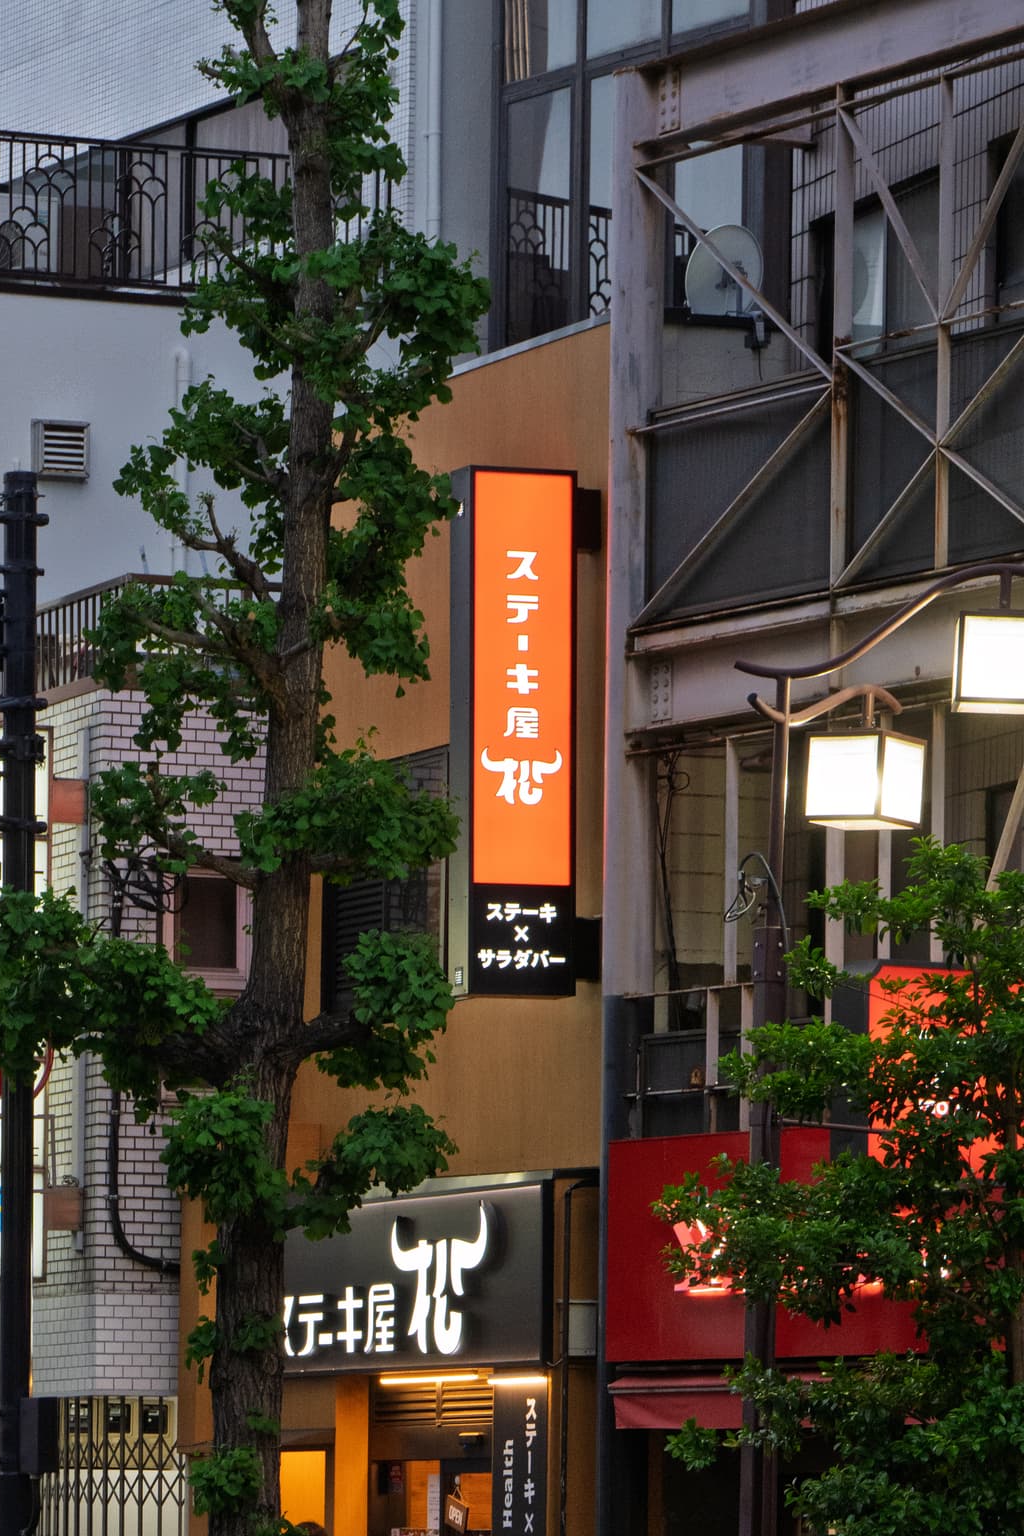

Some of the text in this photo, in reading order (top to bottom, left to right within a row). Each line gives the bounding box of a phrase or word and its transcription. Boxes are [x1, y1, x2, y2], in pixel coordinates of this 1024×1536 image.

[504, 550, 539, 738] ステーキ屋
[486, 902, 558, 921] ステーキ
[477, 948, 566, 970] サラダバー
[503, 1439, 514, 1528] Health
[448, 1505, 463, 1527] OPEN
